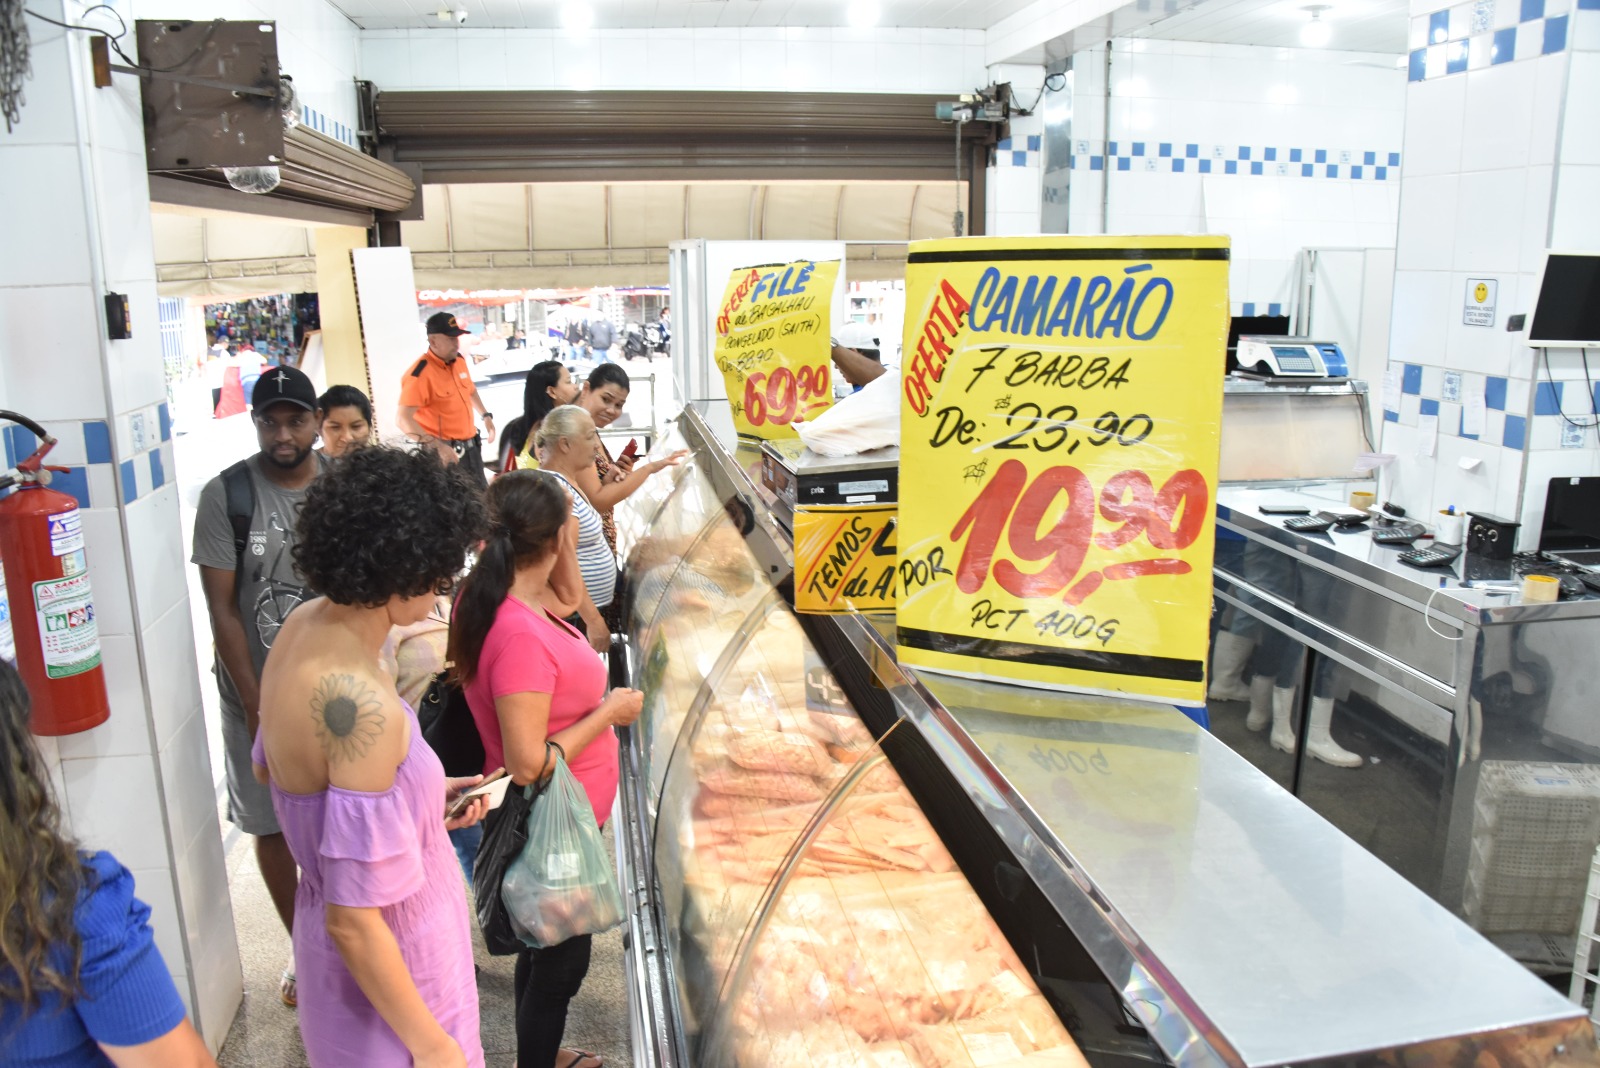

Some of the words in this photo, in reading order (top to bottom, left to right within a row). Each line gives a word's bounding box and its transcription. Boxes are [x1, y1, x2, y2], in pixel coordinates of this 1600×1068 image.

[717, 269, 760, 337] OFERTA
[734, 312, 749, 326] de
[778, 314, 821, 339] (SAITH)
[969, 263, 1174, 341] CAMARÃO
[904, 278, 971, 417] OFERTA
[965, 344, 1011, 393] 7
[1004, 351, 1133, 390] BARBA
[929, 406, 987, 448] De:
[993, 402, 1154, 455] 23,90
[808, 516, 872, 602] TEMOS
[843, 567, 868, 597] de
[869, 566, 897, 600] A
[899, 546, 954, 597] POR
[971, 599, 1030, 632] PCT
[1034, 613, 1120, 646] 400G
